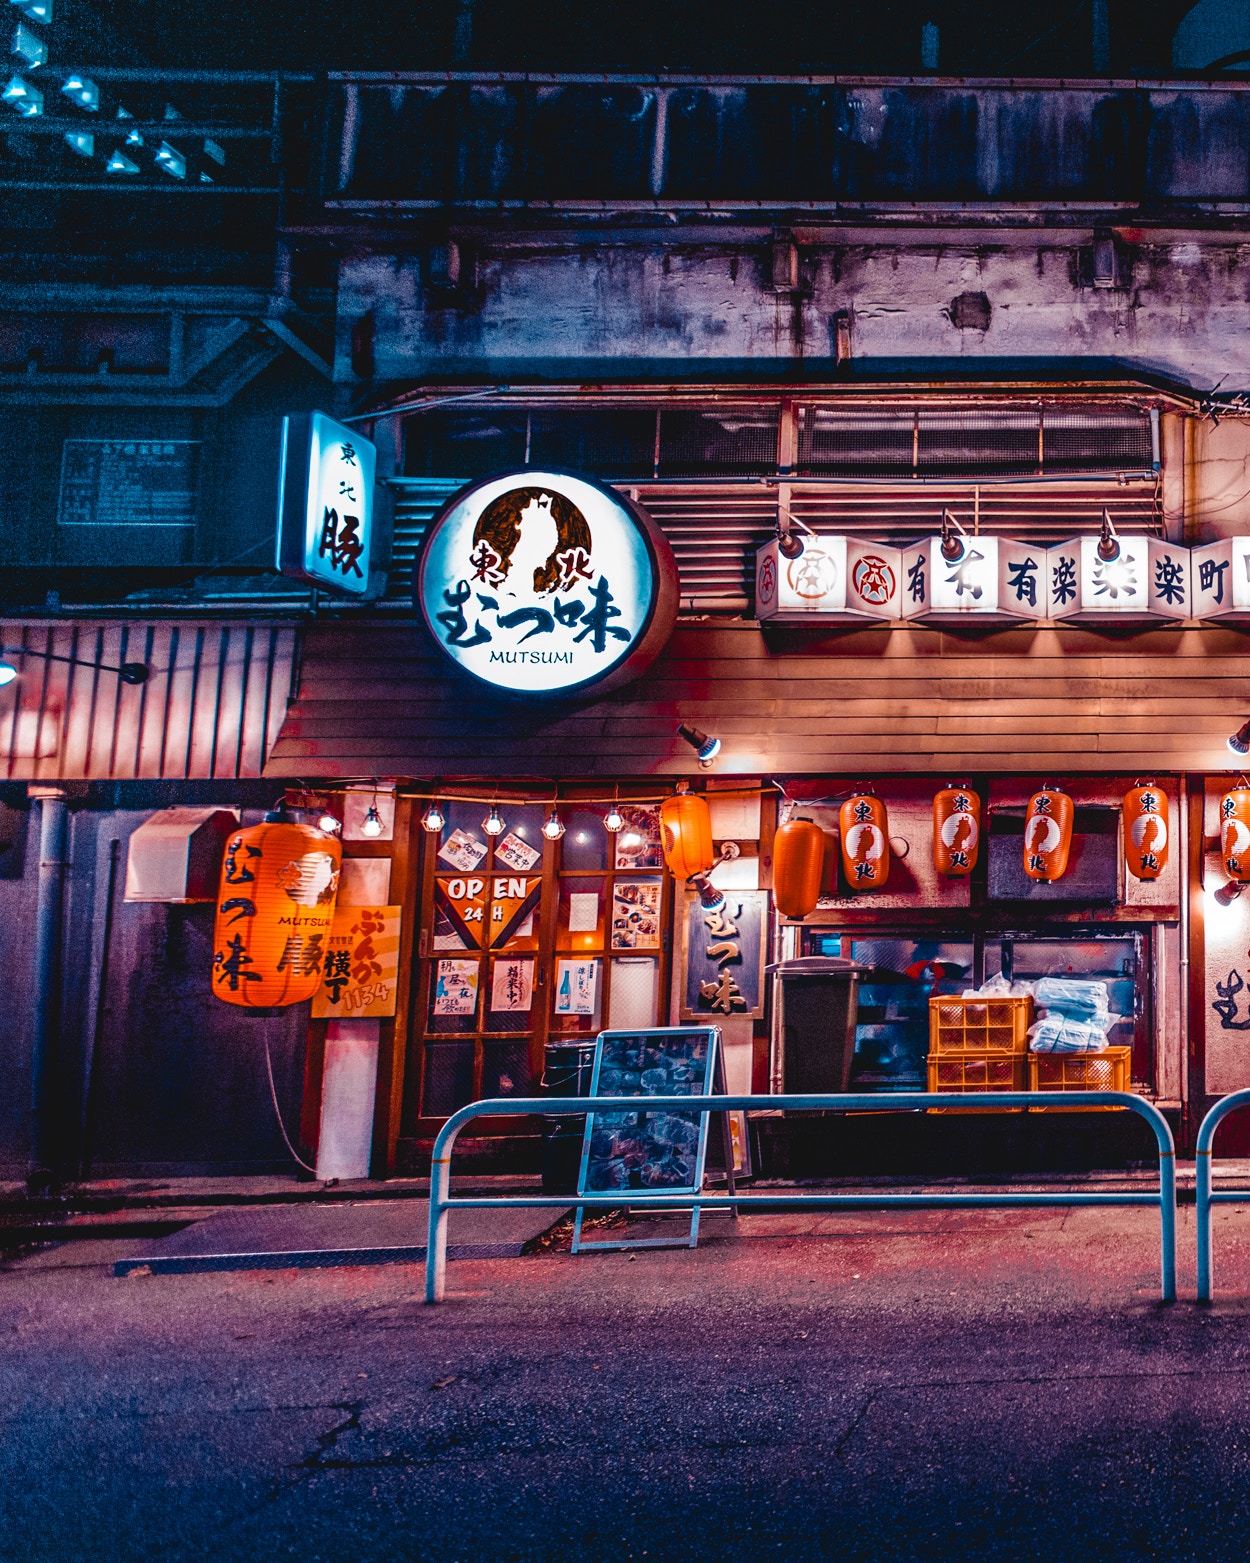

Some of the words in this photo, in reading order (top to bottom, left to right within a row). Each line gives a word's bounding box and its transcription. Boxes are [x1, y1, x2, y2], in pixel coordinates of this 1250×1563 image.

[908, 554, 925, 603] 有
[1007, 557, 1039, 607] 有
[1051, 557, 1077, 607] 楽
[1155, 554, 1185, 605] 楽
[1199, 559, 1229, 606] 町
[436, 575, 632, 653] むつ味
[489, 651, 573, 664] MUTSUMI
[351, 910, 385, 985] ぶんか
[324, 951, 351, 1005] 横丁
[342, 983, 389, 1011] 1134
